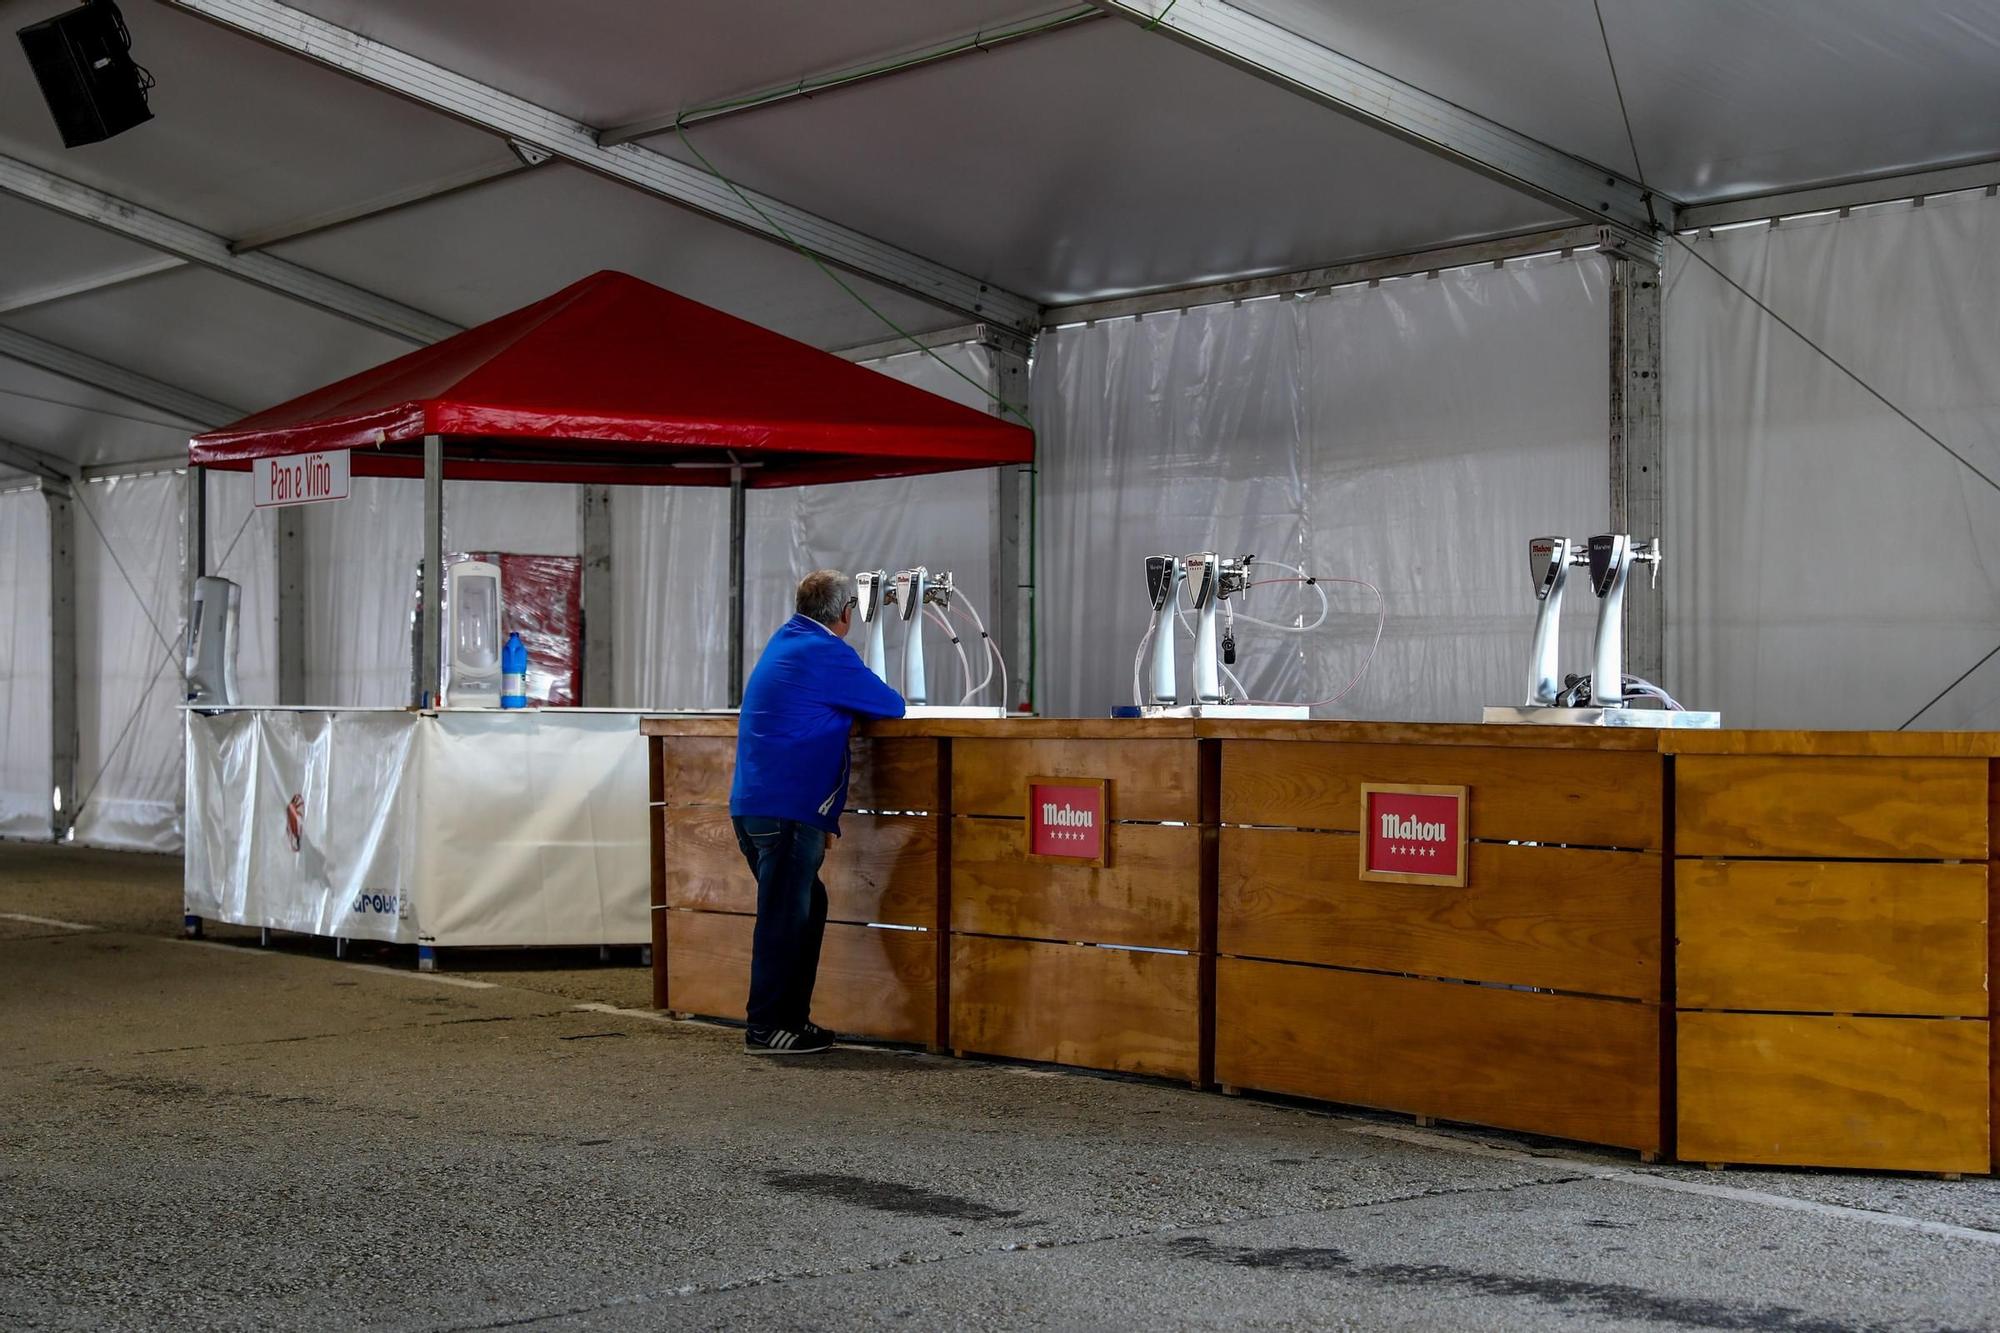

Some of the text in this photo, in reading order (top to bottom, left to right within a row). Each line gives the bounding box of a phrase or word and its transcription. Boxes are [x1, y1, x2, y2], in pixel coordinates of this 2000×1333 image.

[271, 454, 331, 500] Pan e Viño
[1042, 803, 1093, 828] Mahou
[1381, 813, 1447, 842] Mahou
